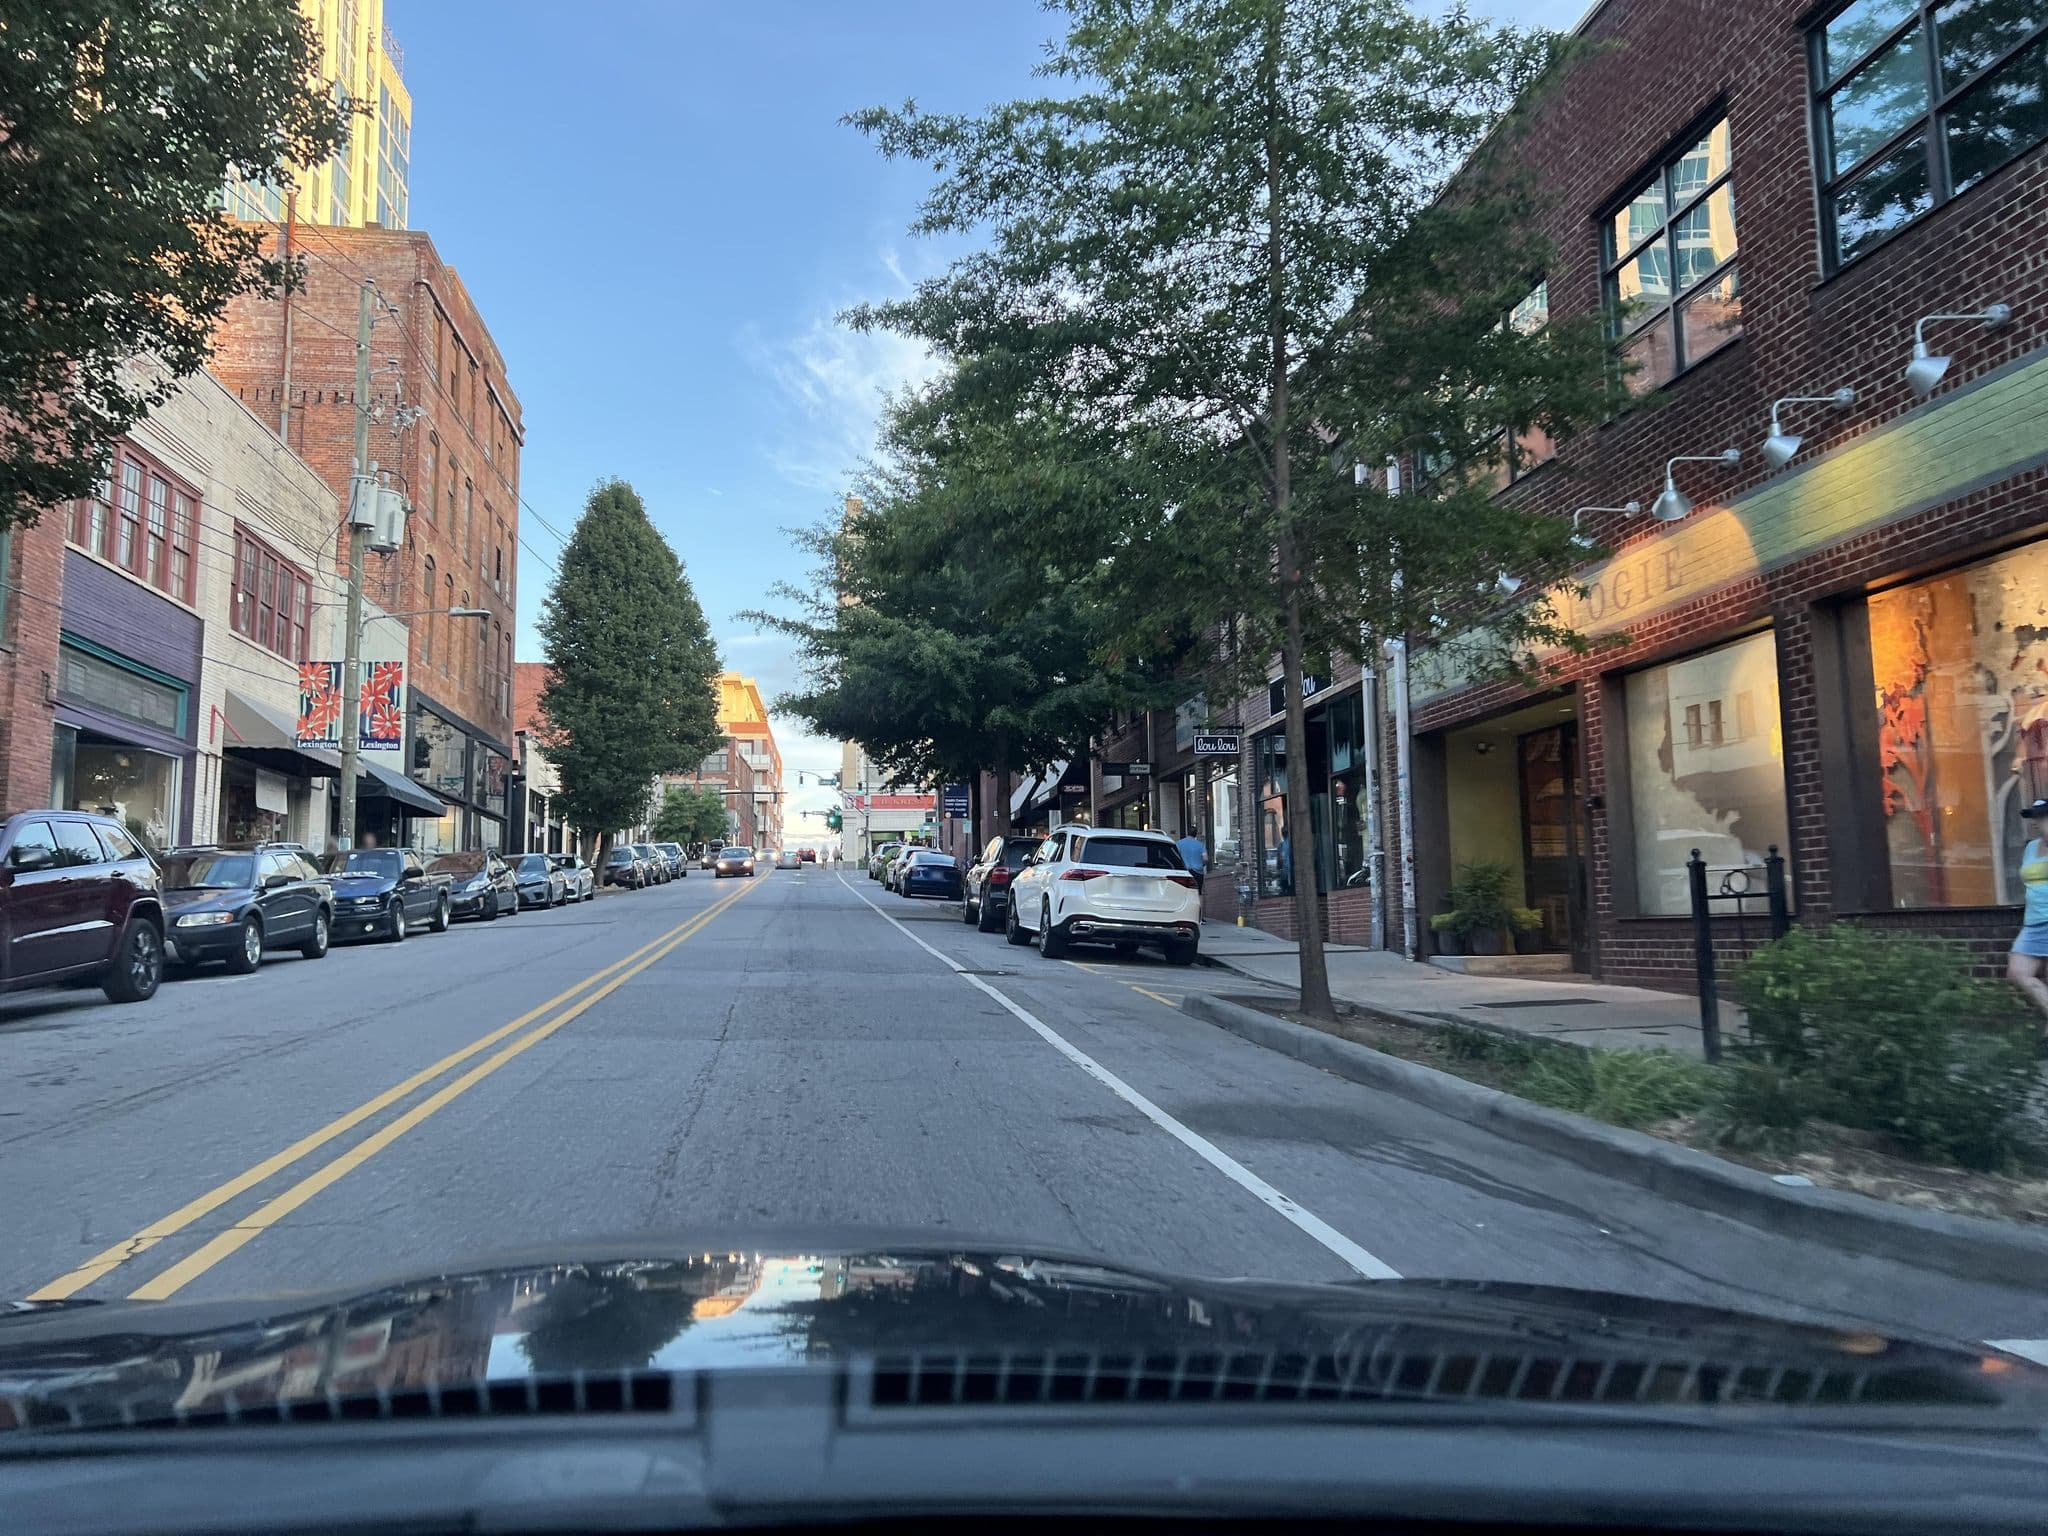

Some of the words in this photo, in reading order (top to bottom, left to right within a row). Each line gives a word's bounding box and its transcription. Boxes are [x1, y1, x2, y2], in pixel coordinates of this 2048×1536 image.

[297, 740, 338, 750] Lexington
[360, 741, 399, 750] Lexington
[1197, 738, 1217, 751] lou
[1217, 738, 1237, 751] lou
